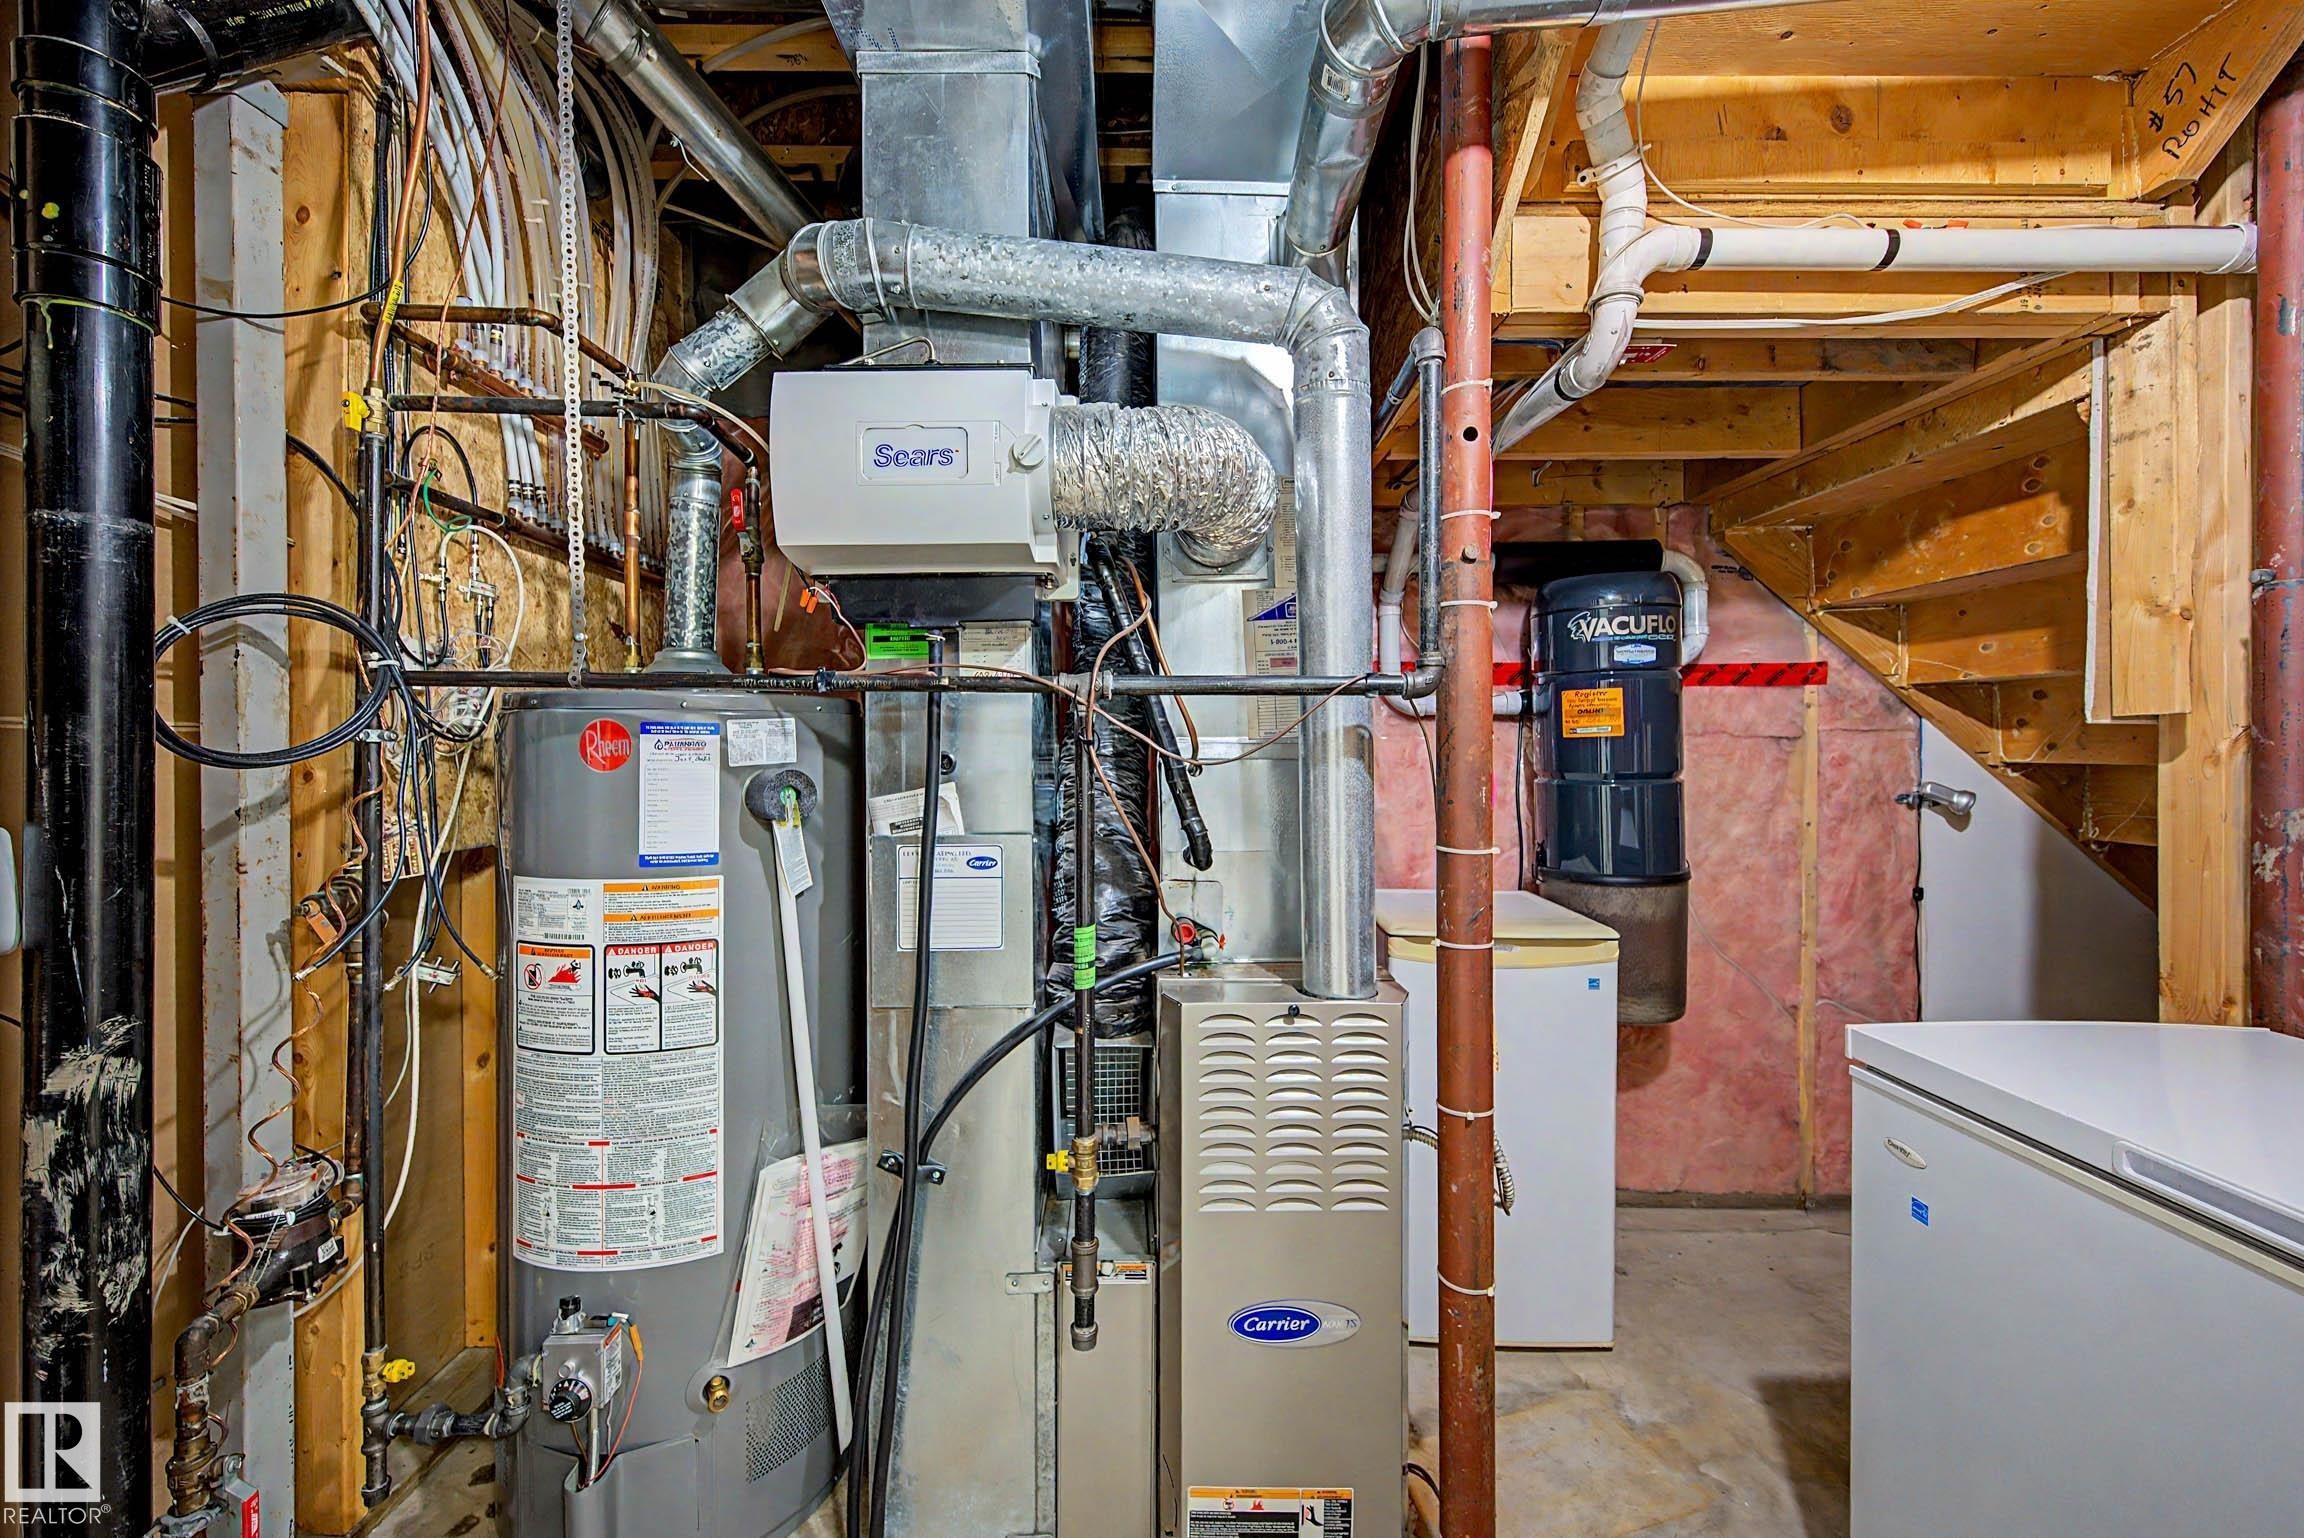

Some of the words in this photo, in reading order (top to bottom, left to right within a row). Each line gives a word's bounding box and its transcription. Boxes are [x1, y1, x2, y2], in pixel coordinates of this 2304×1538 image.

[873, 443, 954, 468] Sears
[1578, 614, 1677, 643] VACUFLO
[586, 720, 631, 766] Rheem
[617, 945, 657, 955] DANGER
[674, 942, 714, 952] DANGER
[1243, 1316, 1311, 1333] Carrier
